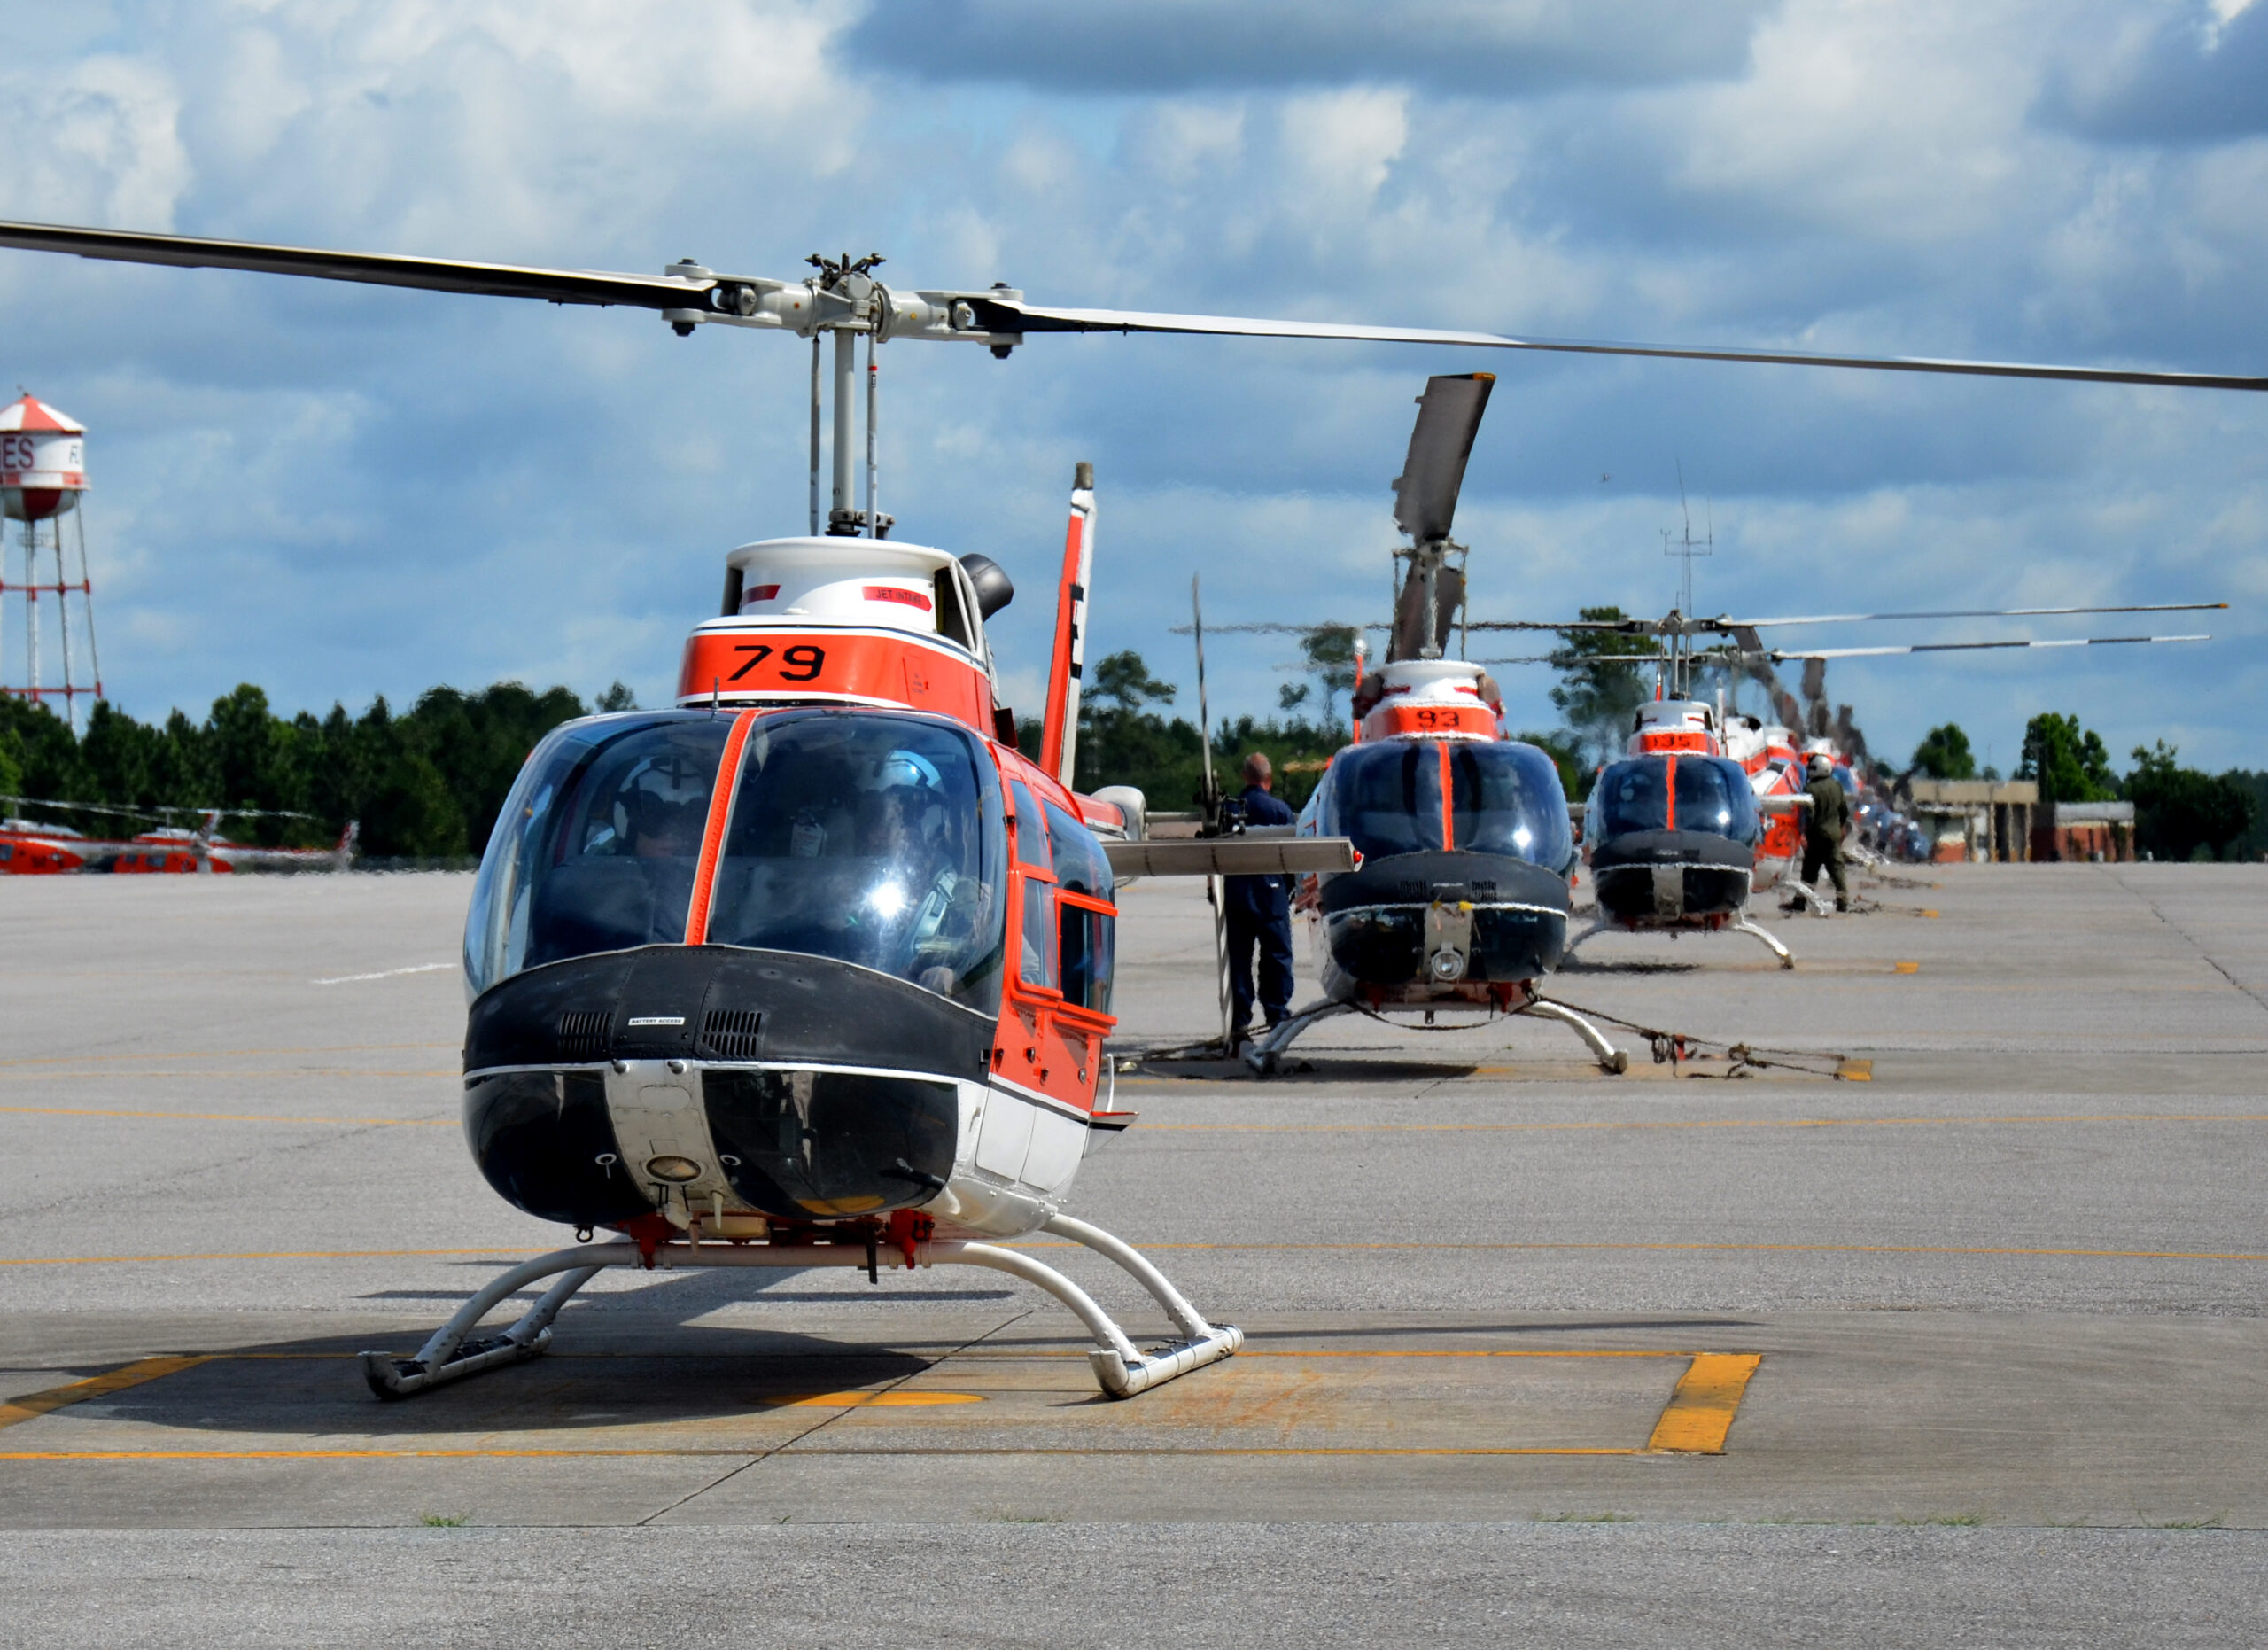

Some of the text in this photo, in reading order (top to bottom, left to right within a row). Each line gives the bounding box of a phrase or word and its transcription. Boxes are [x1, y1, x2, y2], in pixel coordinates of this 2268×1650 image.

[876, 589, 922, 606] JET INTAKE
[726, 645, 826, 681] 79
[1417, 710, 1460, 728] 93
